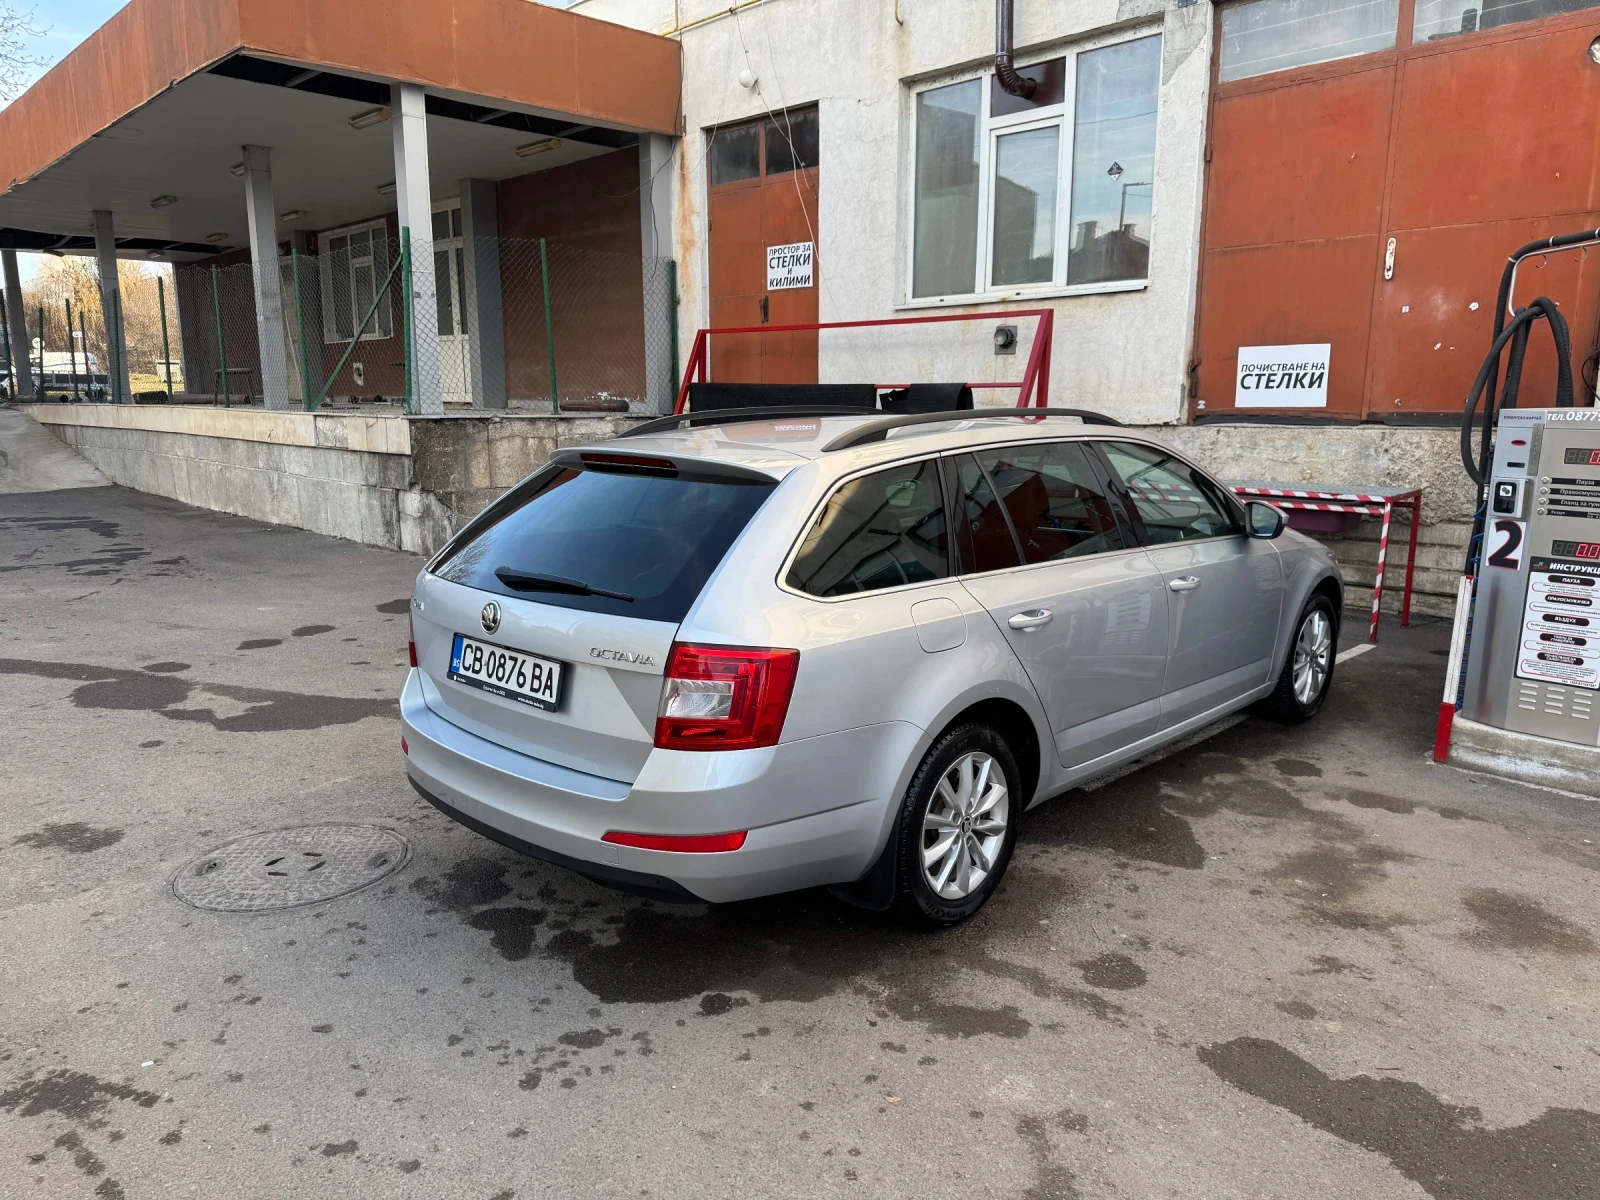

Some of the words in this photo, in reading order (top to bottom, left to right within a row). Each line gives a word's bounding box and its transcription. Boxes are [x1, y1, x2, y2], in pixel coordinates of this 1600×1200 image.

[769, 246, 800, 256] ПРОСТОР
[769, 253, 811, 269] СТЕЛКИ
[769, 274, 811, 288] КИЛИМИ
[1240, 362, 1310, 373] ПОЧИСТВАНЕ
[1310, 361, 1326, 371] НА
[1240, 372, 1325, 390] СТЕЛКИ
[1488, 519, 1523, 570] 2
[589, 646, 656, 667] OCTAVIA
